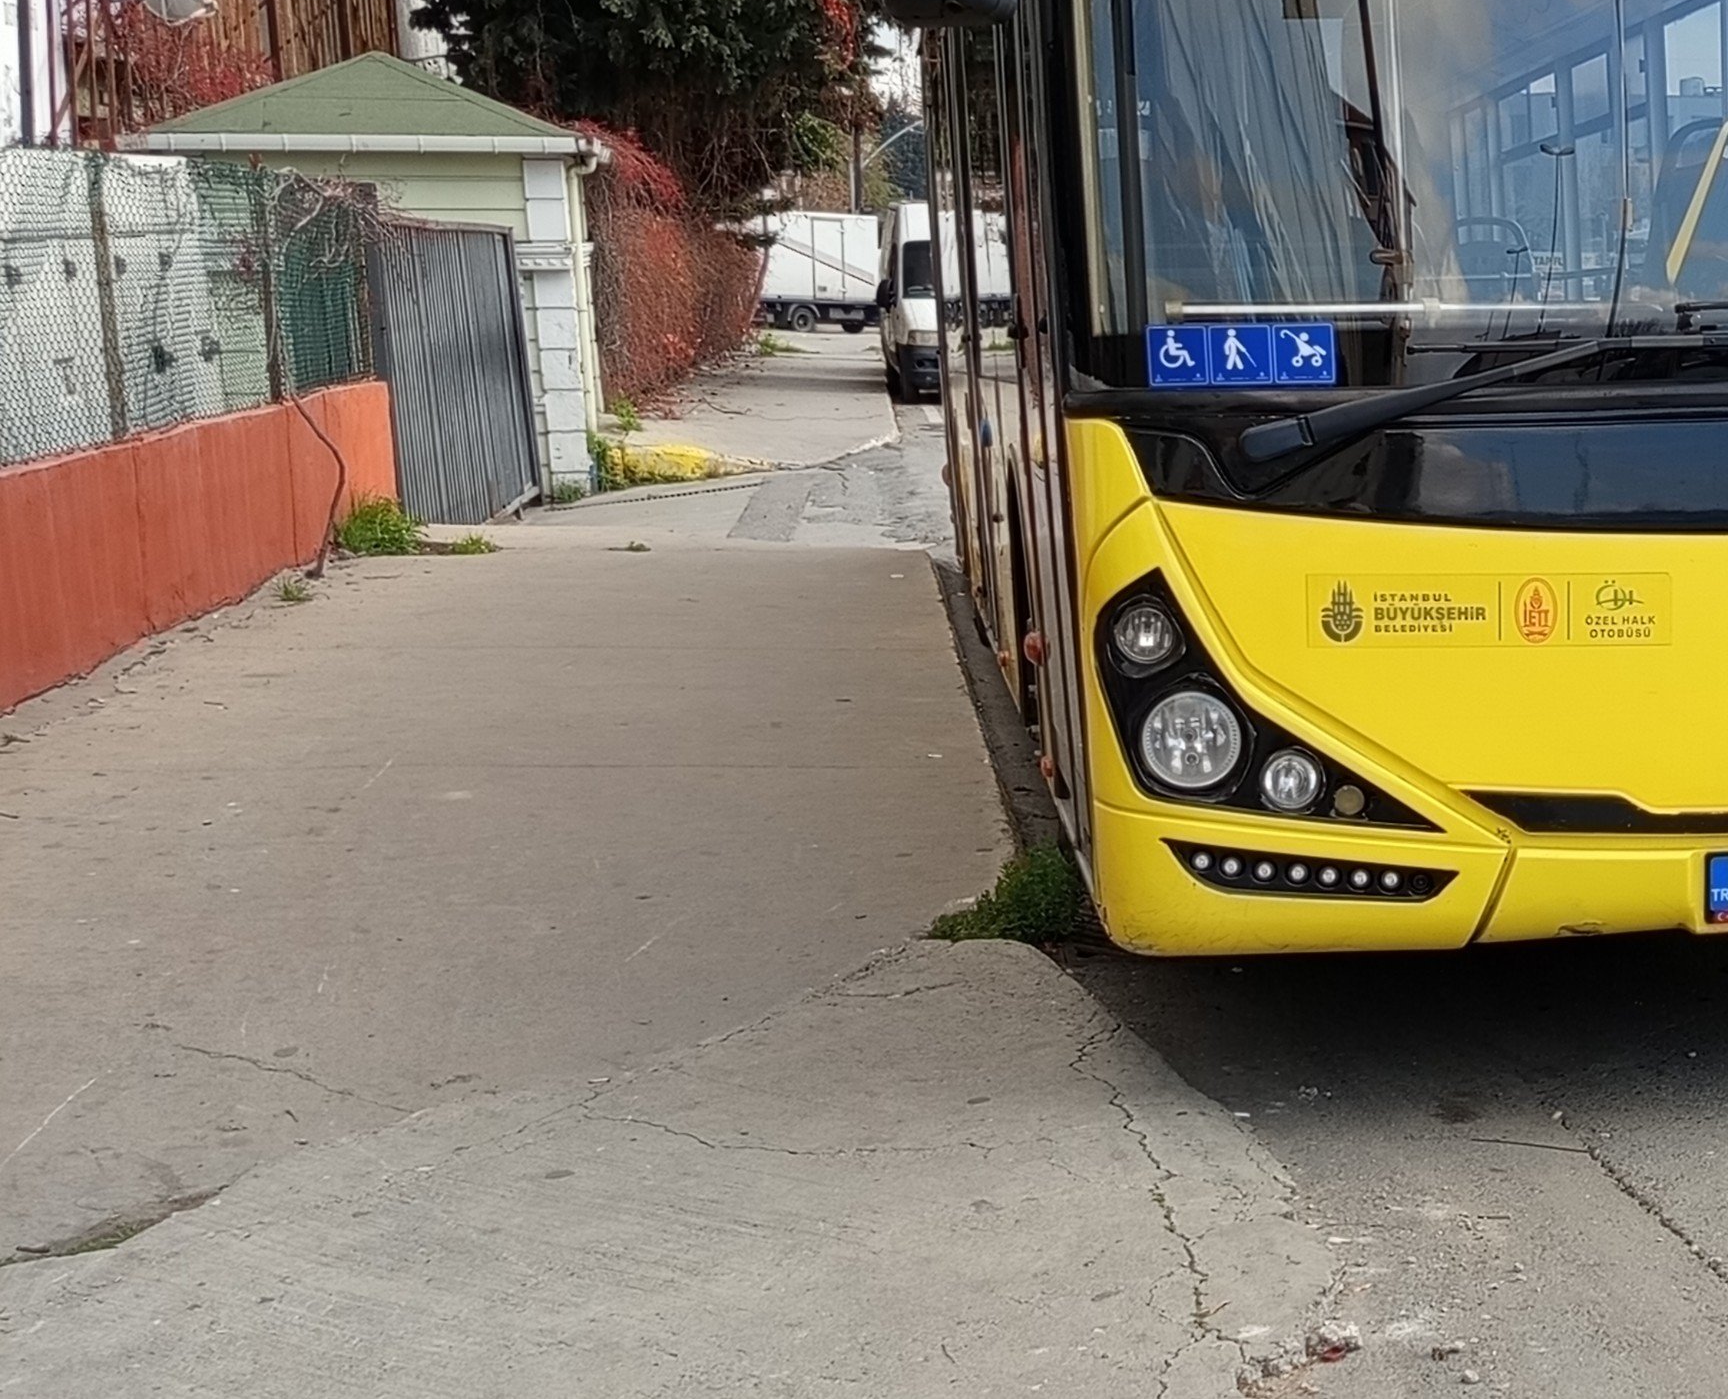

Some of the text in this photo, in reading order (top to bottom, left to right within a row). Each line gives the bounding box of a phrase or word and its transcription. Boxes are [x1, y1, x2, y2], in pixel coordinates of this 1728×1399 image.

[1373, 591, 1452, 602] İSTANBUL
[1585, 614, 1656, 626] ÖZEL HALK
[1374, 623, 1453, 633] BELEDİYESİ
[1589, 627, 1651, 639] OTOBÜSÜ
